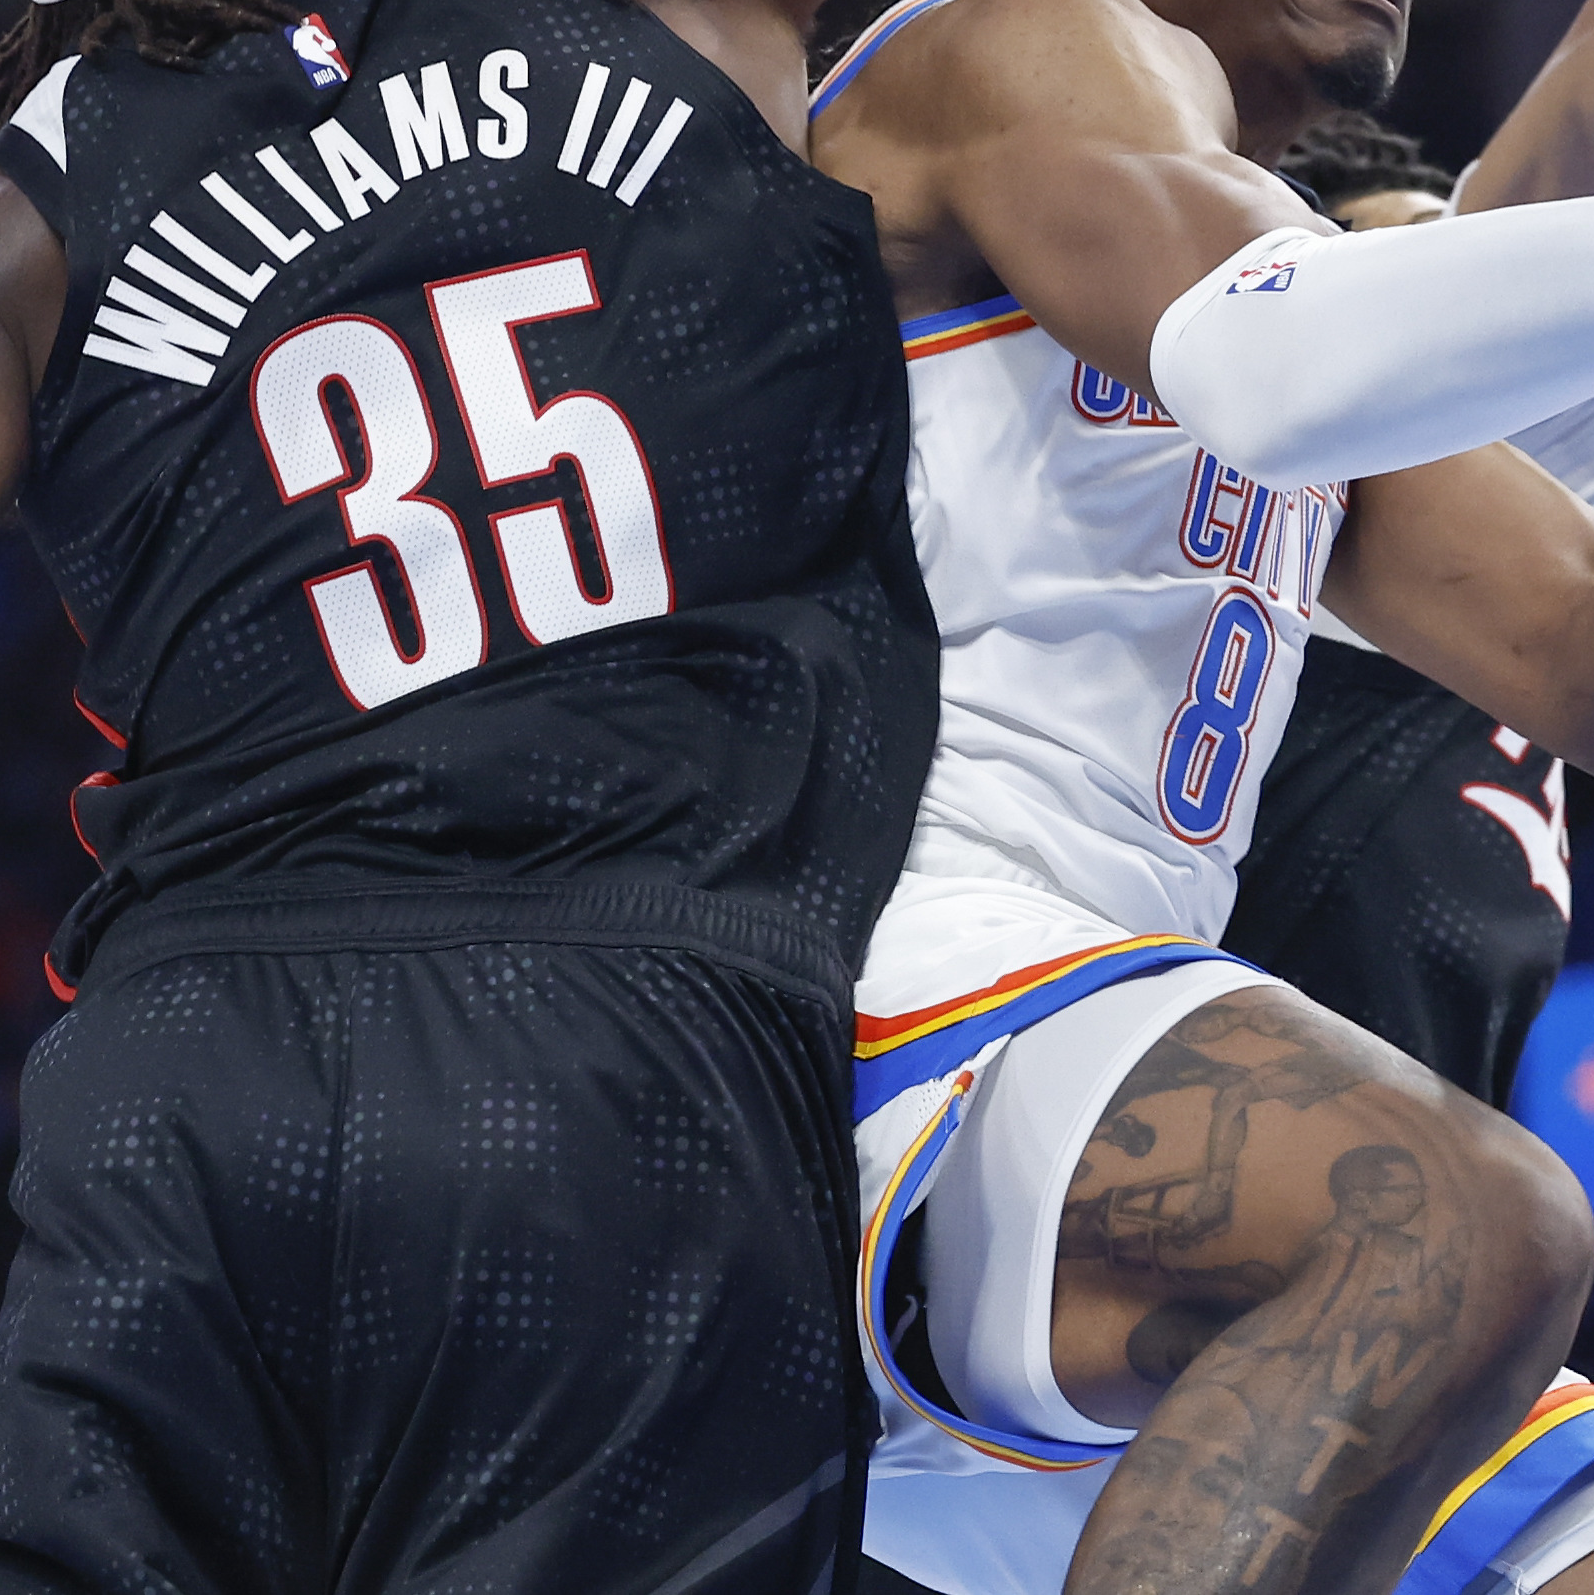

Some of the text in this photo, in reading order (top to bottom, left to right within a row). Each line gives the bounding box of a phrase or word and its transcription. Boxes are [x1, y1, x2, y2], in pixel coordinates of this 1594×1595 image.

[82, 48, 694, 387] WILLIAMS III
[312, 66, 338, 87] NBA
[249, 249, 676, 712] 35
[1156, 585, 1276, 847] 8
